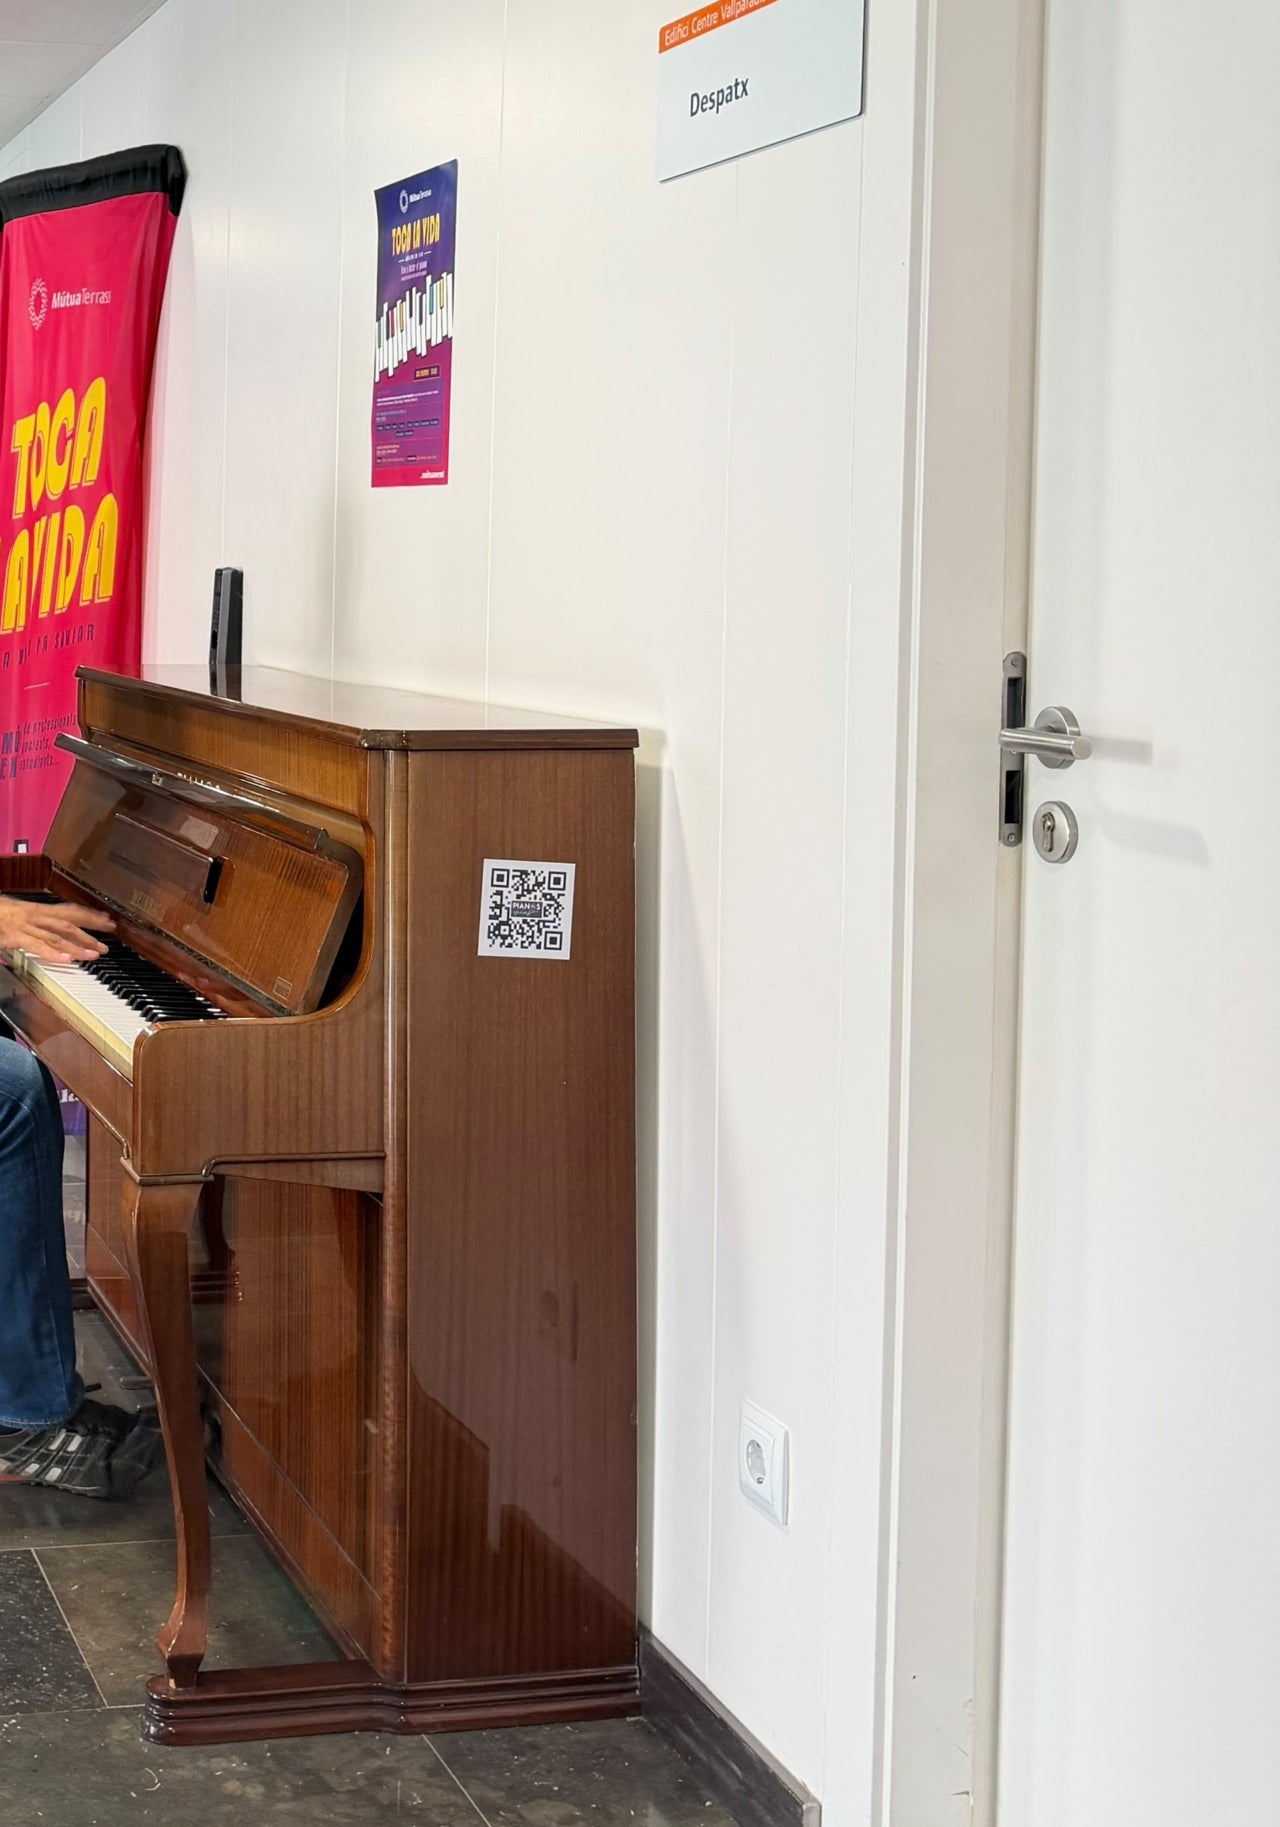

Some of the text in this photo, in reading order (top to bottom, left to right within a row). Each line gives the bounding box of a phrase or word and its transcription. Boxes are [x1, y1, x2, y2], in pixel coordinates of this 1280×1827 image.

[664, 21, 689, 46] Edifici
[691, 12, 718, 34] Centre
[690, 78, 749, 117] Despatx
[392, 222, 411, 256] TOCA
[422, 212, 439, 246] VIDA
[11, 376, 106, 519] TOCA
